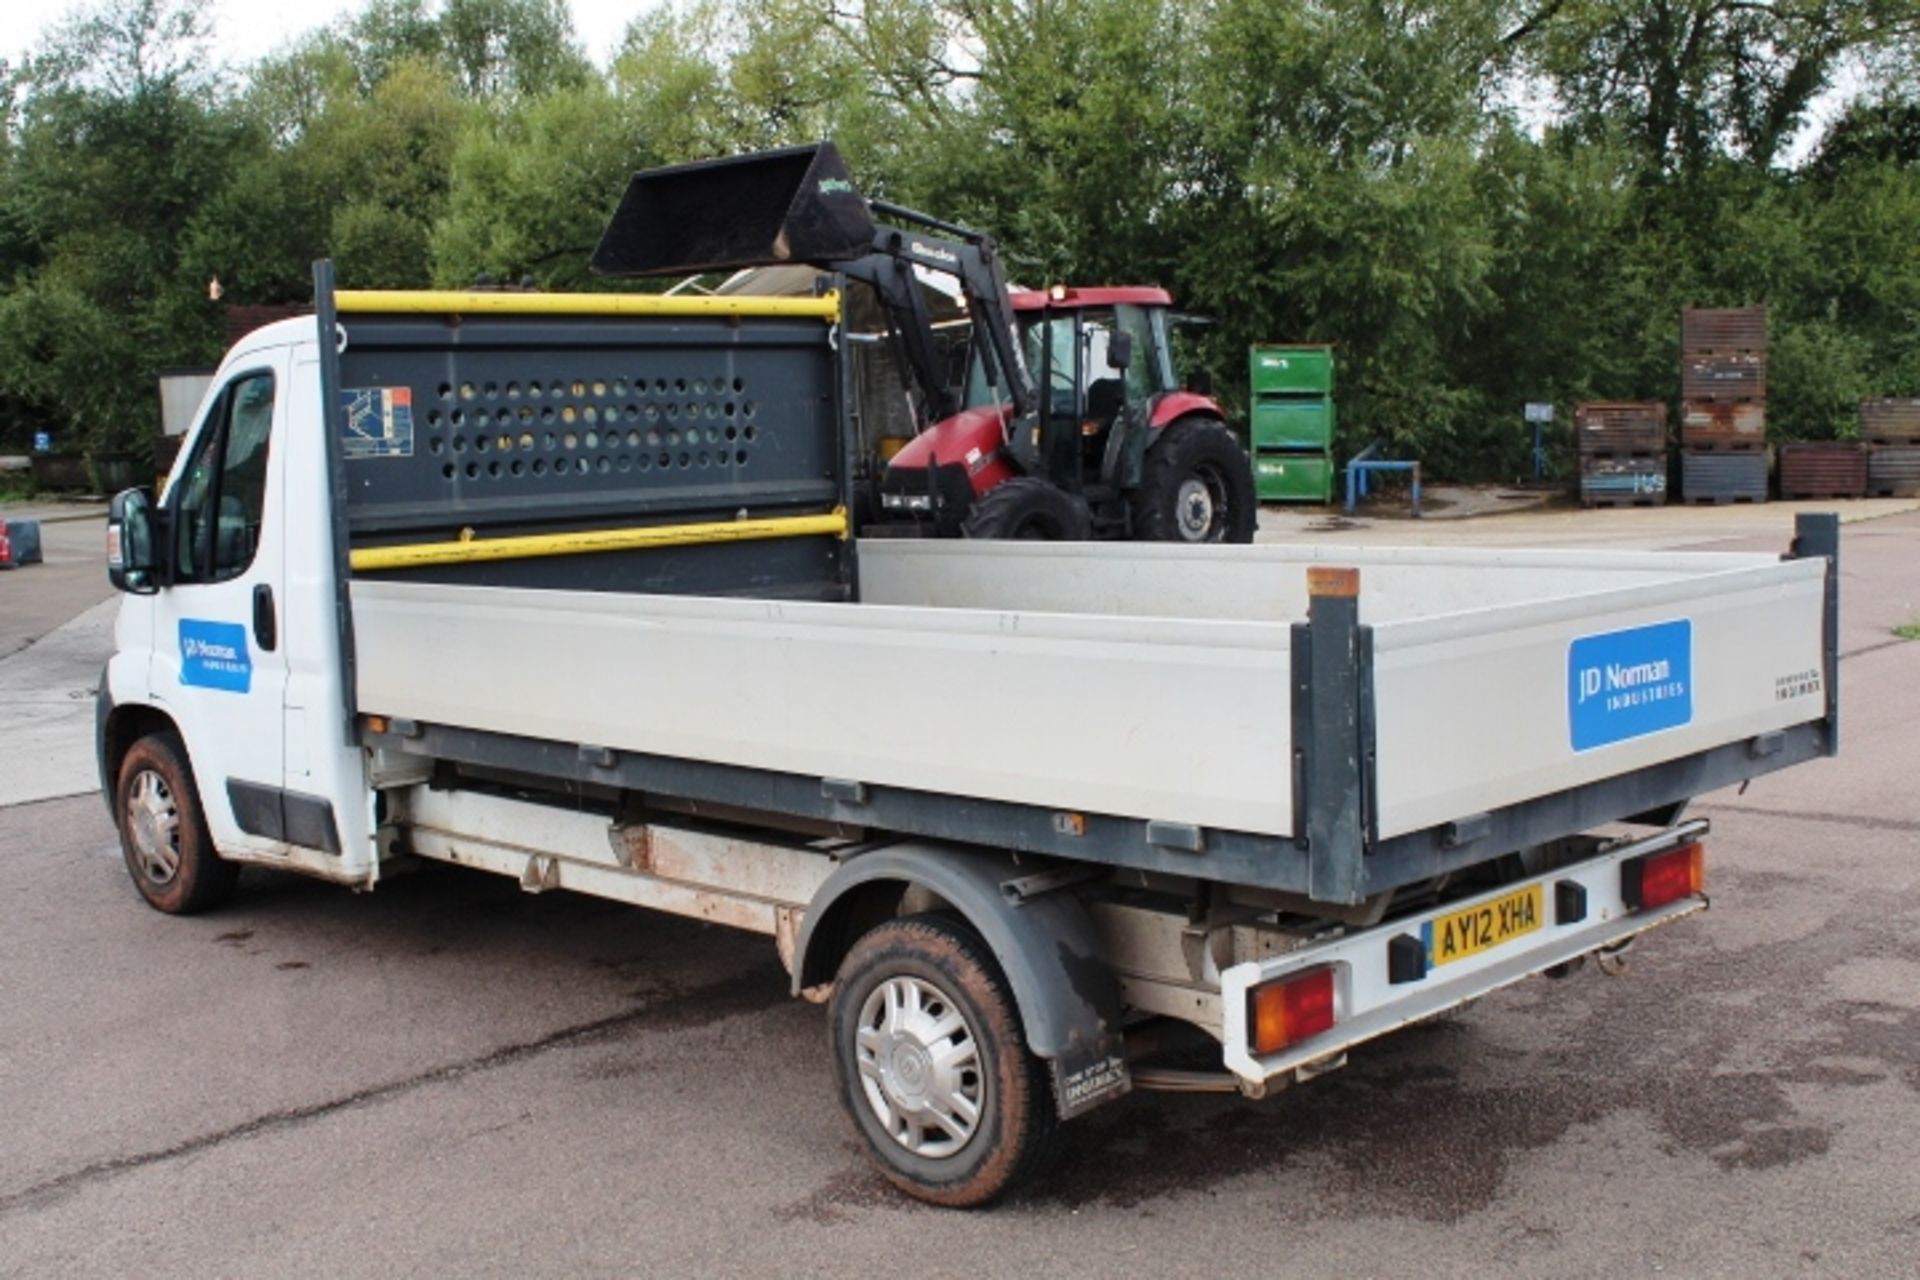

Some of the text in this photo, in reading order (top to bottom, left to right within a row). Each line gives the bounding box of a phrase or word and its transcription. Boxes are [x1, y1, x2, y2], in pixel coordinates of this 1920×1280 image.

[1579, 658, 1671, 704] JD Norman
[1607, 681, 1684, 712] INDUSTRIES
[1442, 892, 1536, 958] AY12 XHA
